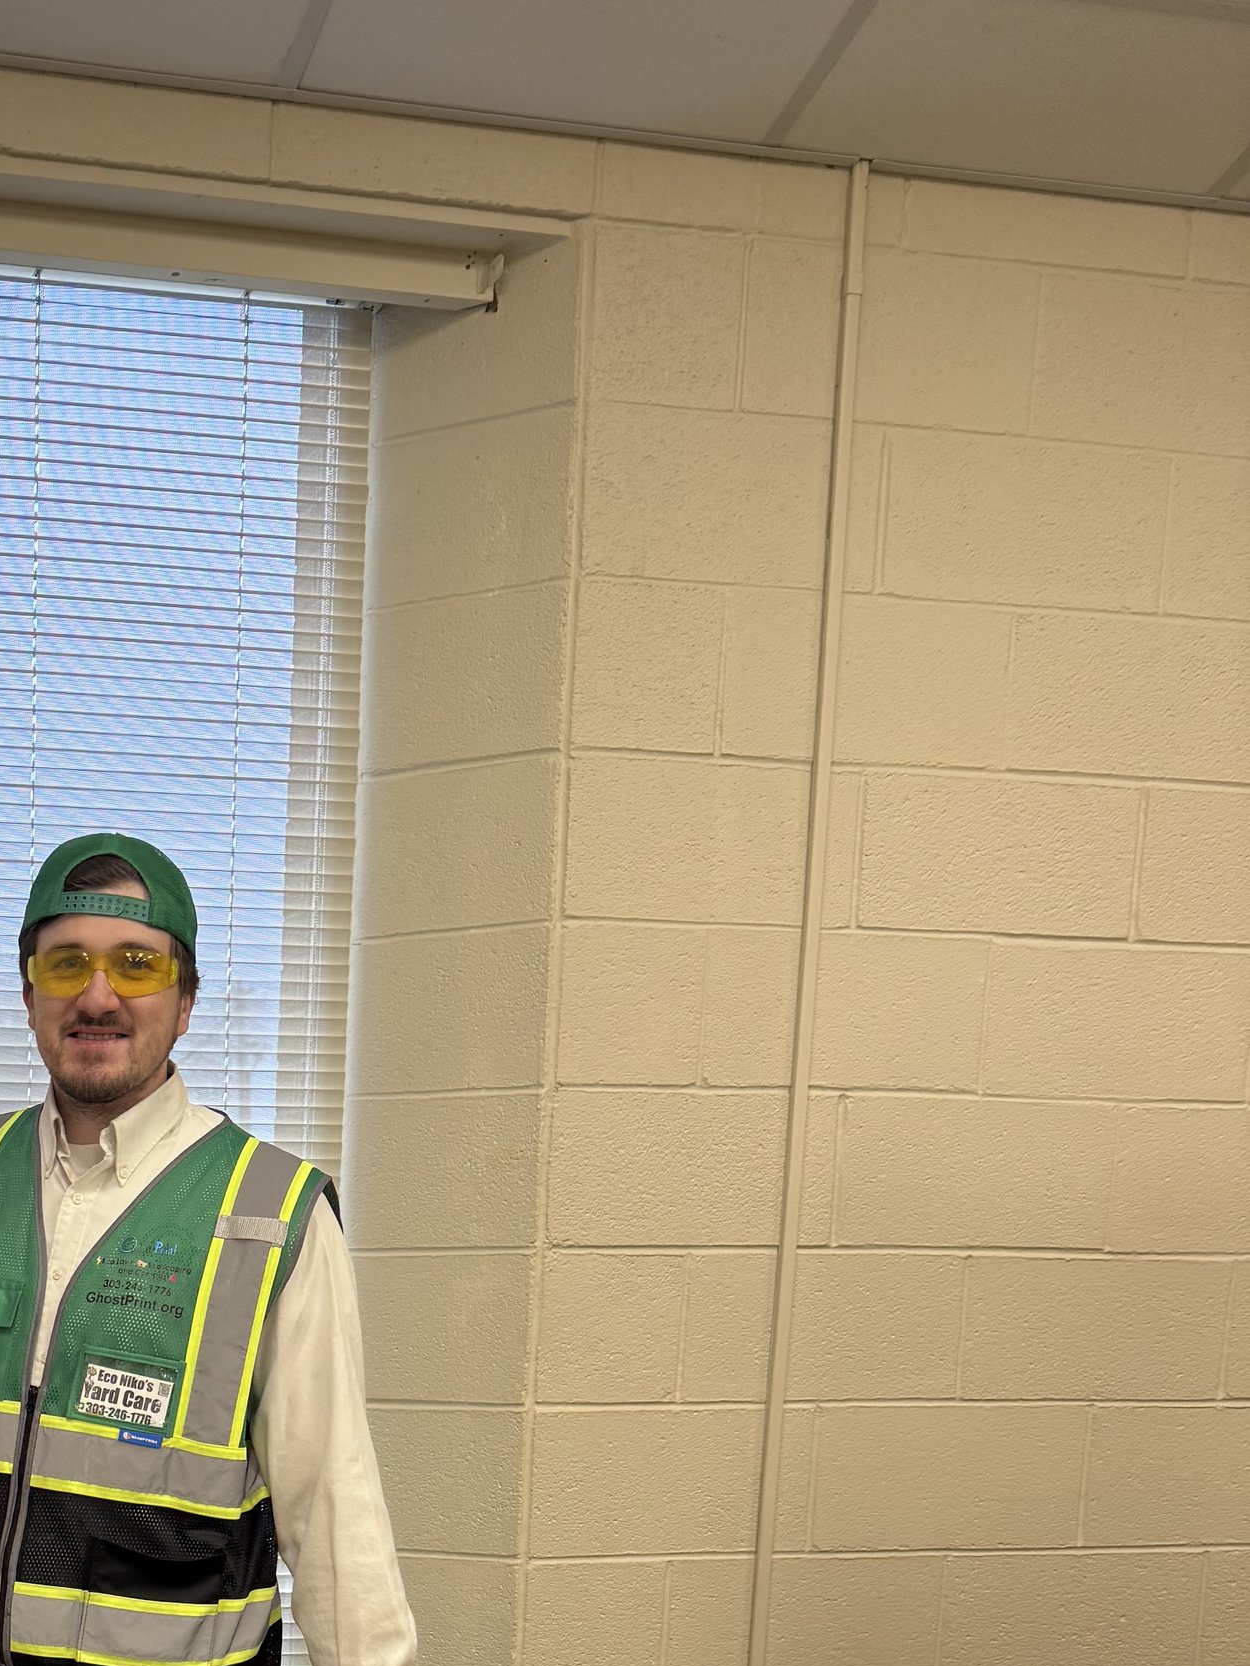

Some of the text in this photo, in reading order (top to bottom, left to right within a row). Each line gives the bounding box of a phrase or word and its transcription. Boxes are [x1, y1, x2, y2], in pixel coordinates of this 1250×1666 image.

[102, 1279, 172, 1297] 303-246-1776
[86, 1291, 184, 1319] GhostPrint.org
[97, 1370, 154, 1392] Eco Niko's
[84, 1382, 162, 1413] Yard Care
[85, 1402, 152, 1425] 303-246-1776
